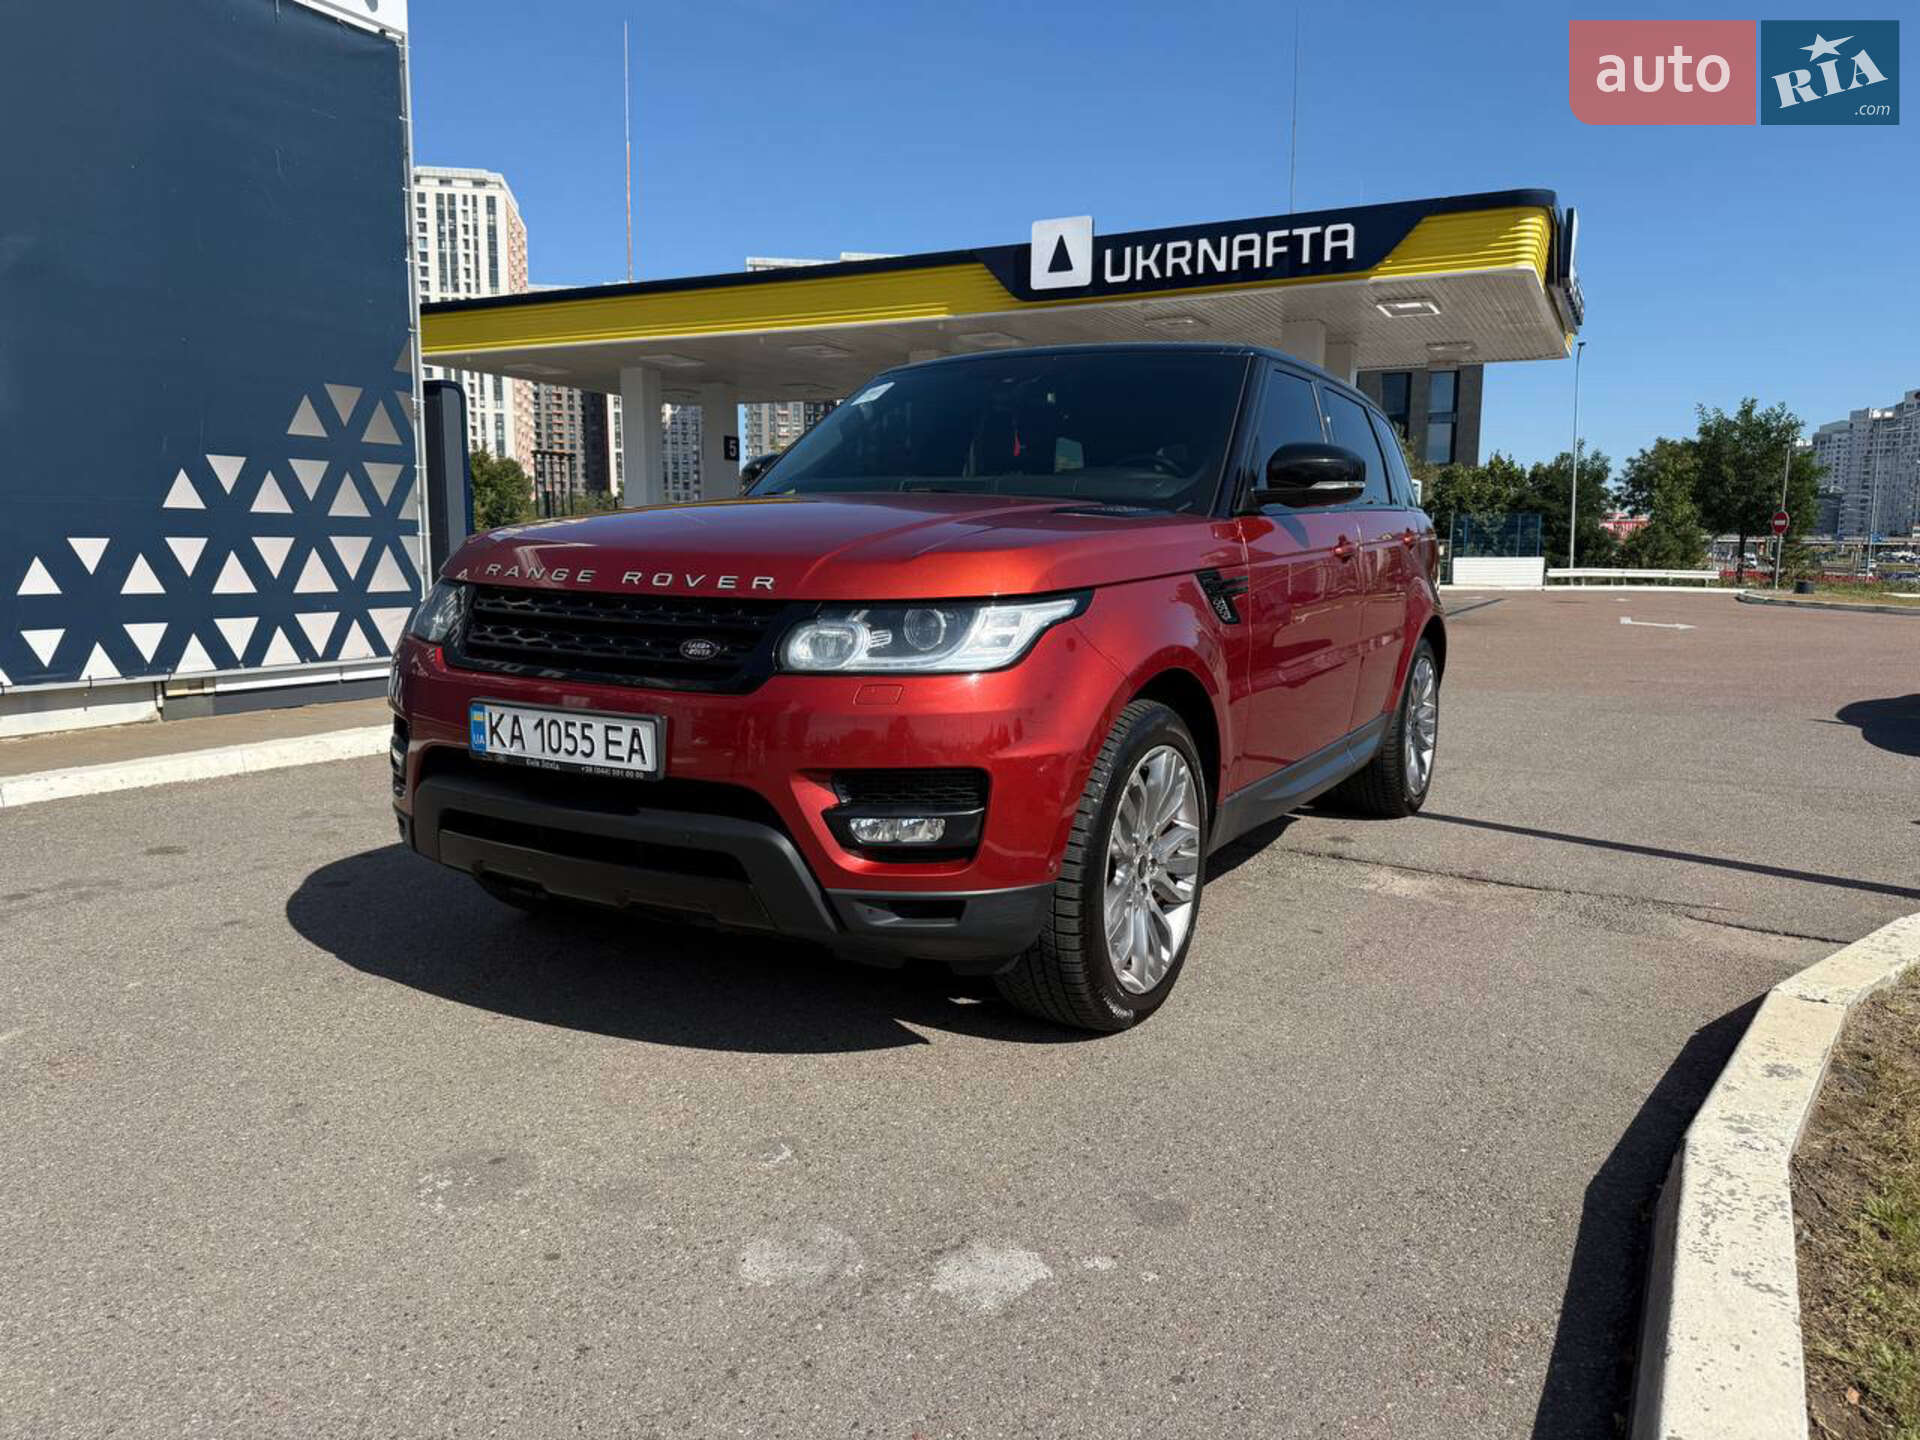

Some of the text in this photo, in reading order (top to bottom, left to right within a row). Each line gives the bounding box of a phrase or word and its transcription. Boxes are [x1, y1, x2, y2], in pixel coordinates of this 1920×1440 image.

[1104, 223, 1355, 284] UKRNAFTA
[729, 440, 737, 457] 5
[485, 563, 775, 589] RANGE ROVER
[472, 733, 485, 745] UA
[489, 711, 647, 765] KA 1055 EA
